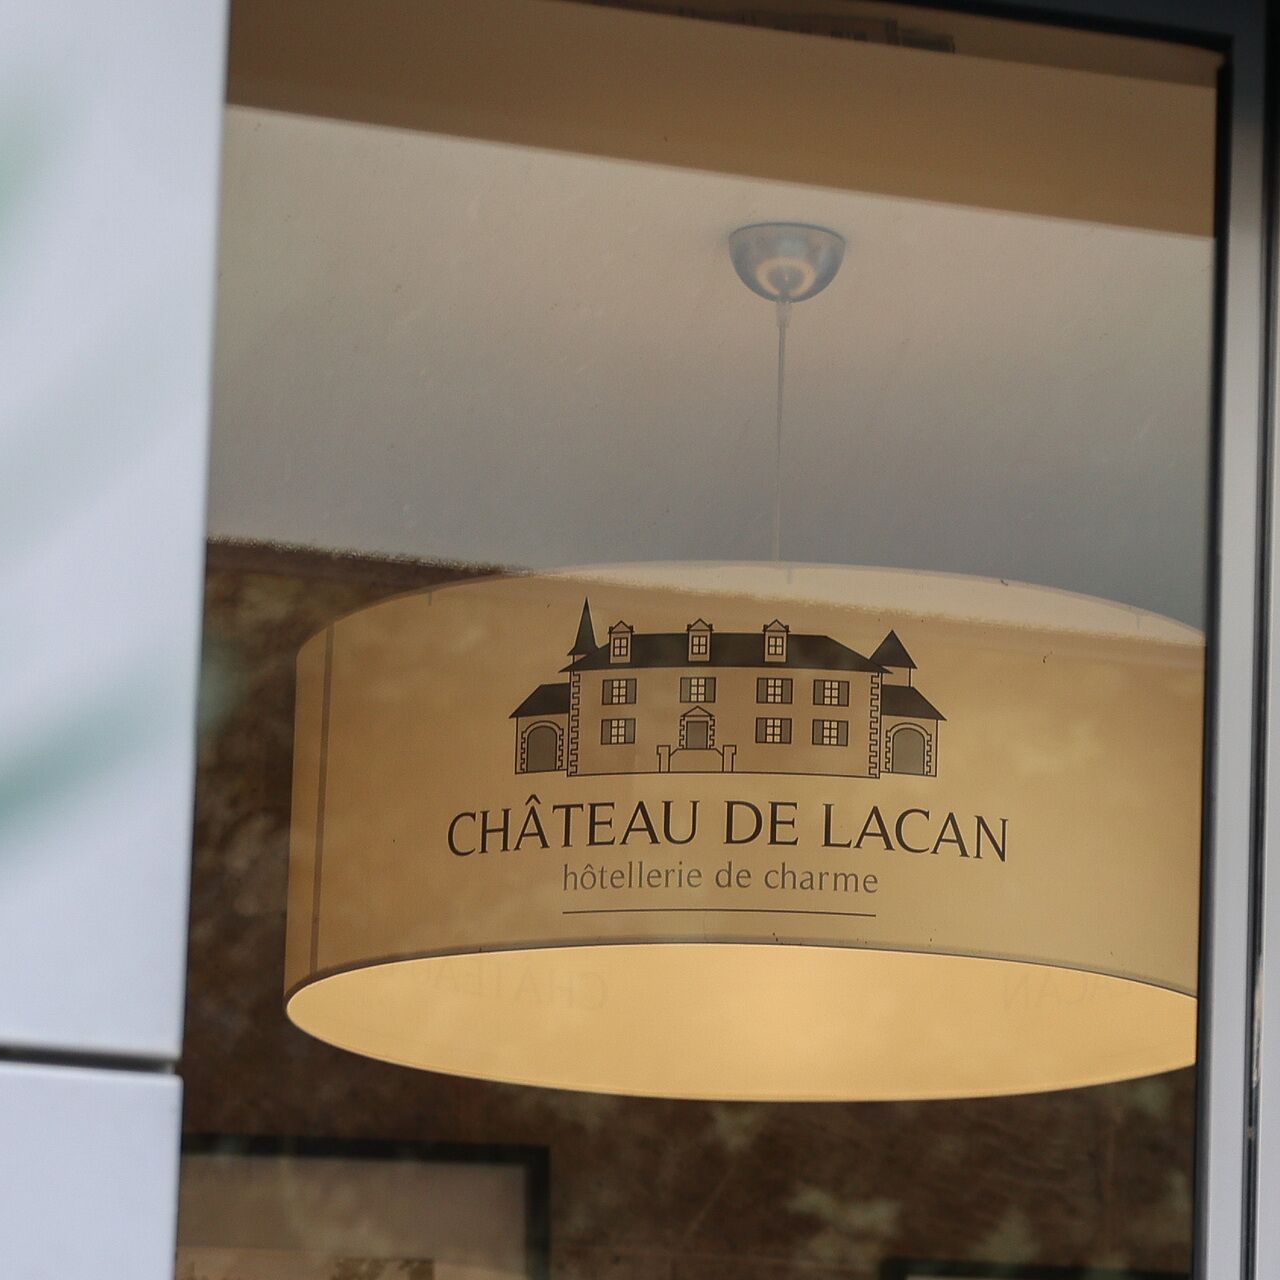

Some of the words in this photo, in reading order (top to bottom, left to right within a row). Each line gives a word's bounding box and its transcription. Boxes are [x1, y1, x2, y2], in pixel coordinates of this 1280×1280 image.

[447, 793, 701, 857] CHÂTEAU
[722, 800, 800, 847] DE
[821, 802, 1009, 862] LACAN
[562, 860, 702, 892] hôtellerie
[715, 860, 752, 889] de
[764, 860, 879, 894] charme
